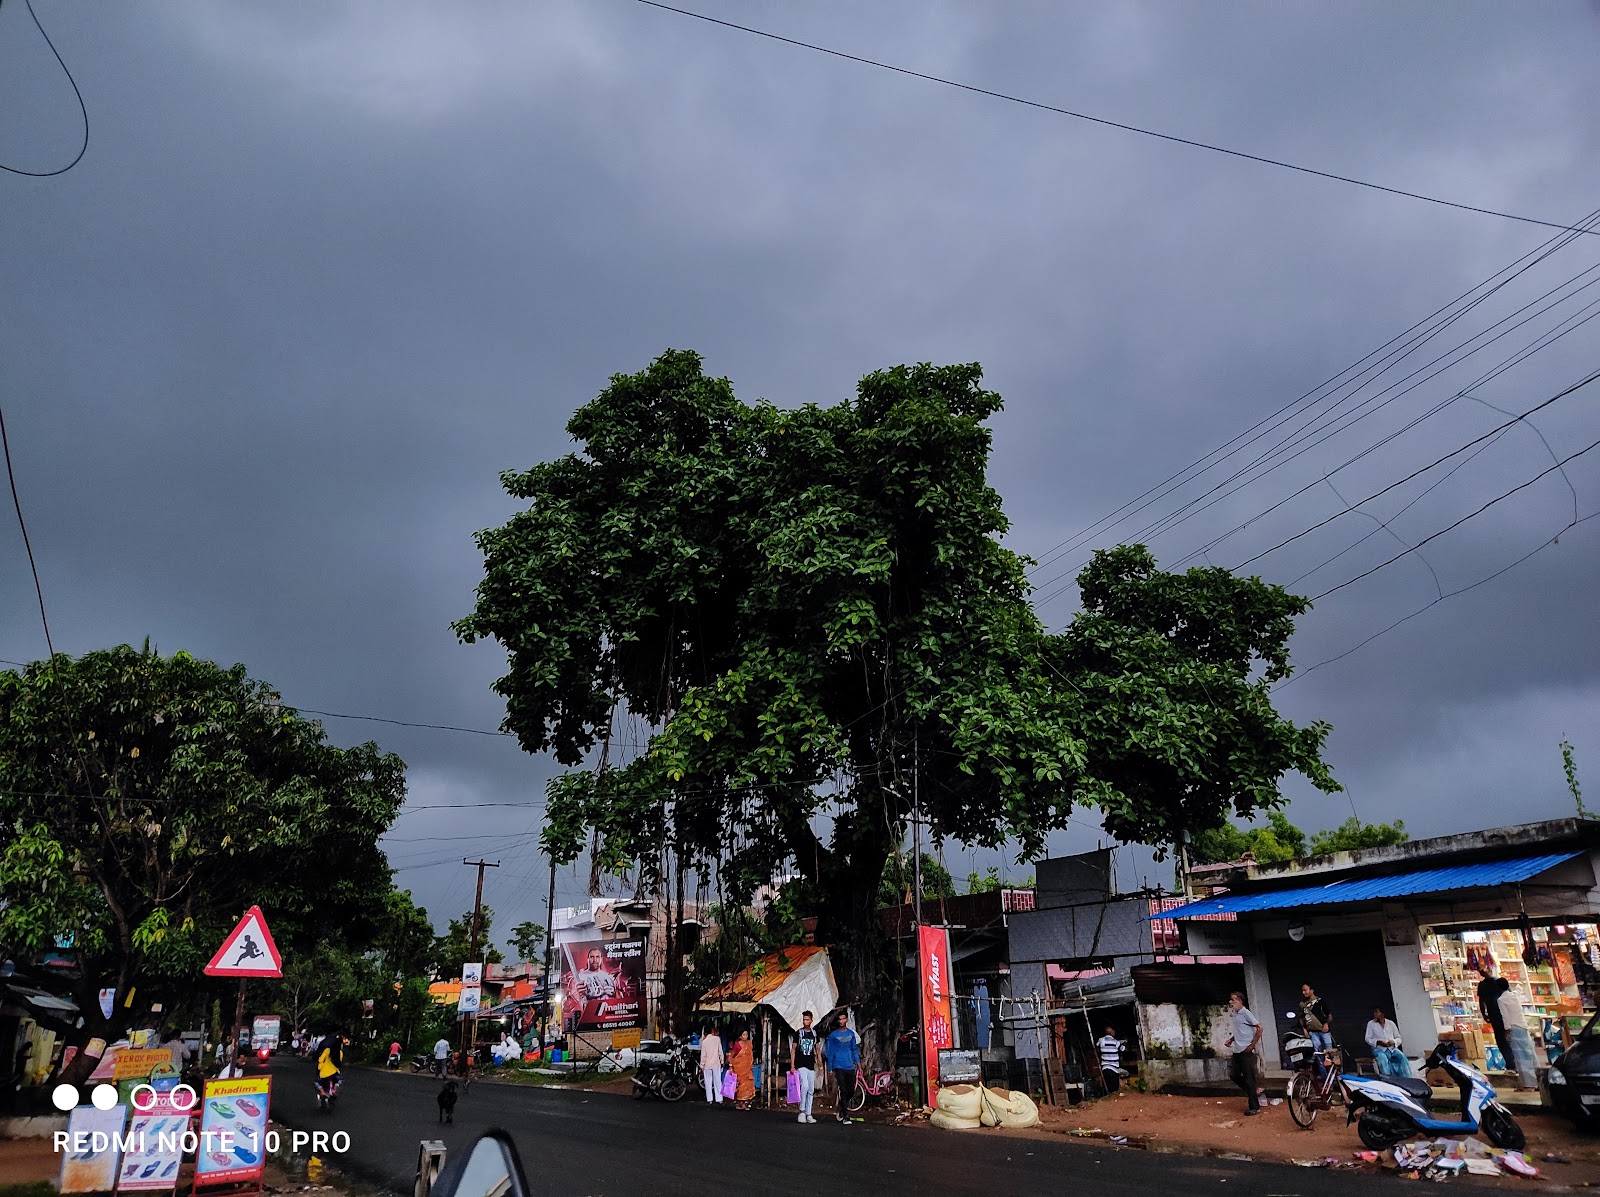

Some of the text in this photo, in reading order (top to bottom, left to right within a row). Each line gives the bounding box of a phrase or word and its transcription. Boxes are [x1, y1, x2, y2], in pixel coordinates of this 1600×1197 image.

[928, 953, 941, 1002] LIVFAST
[117, 1053, 169, 1063] XEROX PHOTO
[213, 1085, 258, 1095] Khadim's
